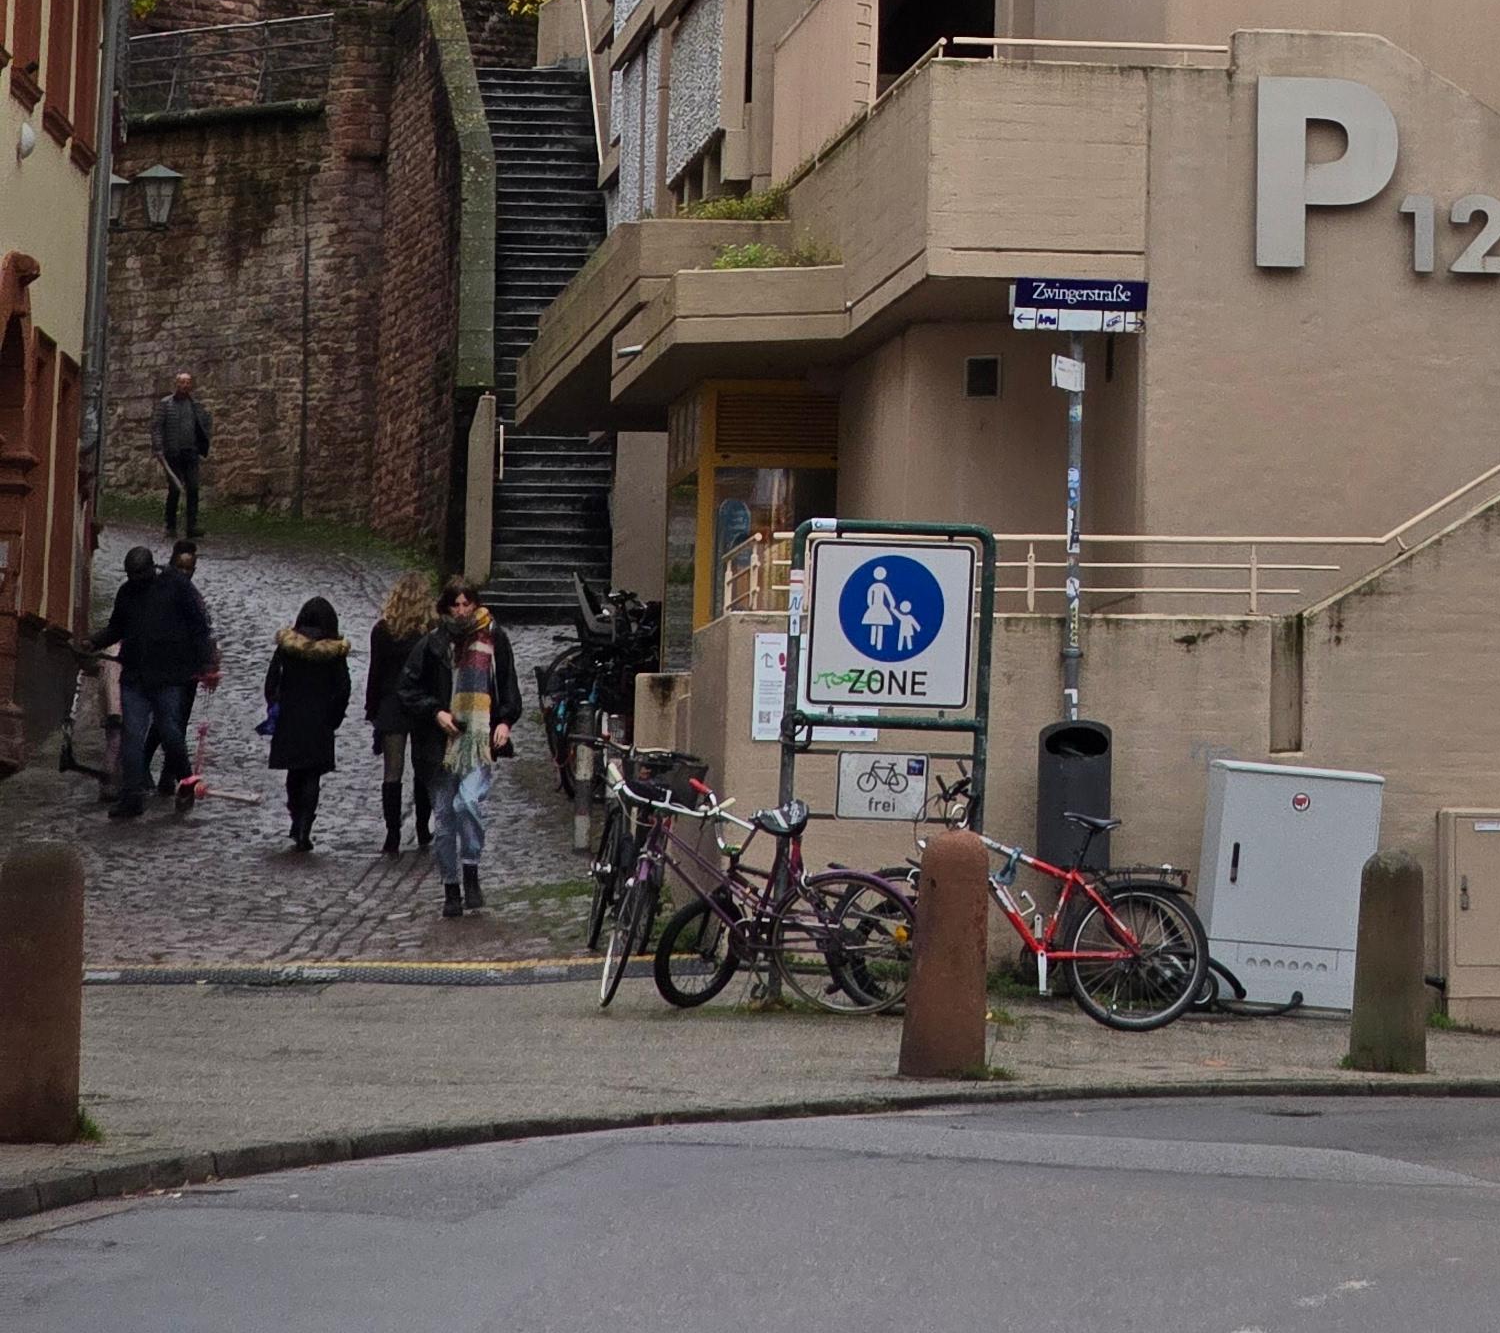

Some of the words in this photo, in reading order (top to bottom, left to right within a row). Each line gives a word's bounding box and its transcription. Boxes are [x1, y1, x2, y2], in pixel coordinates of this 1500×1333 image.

[1255, 75, 1399, 268] P
[1032, 281, 1132, 304] Zwingerstraße
[847, 668, 928, 697] ZONE
[867, 796, 896, 813] frei
